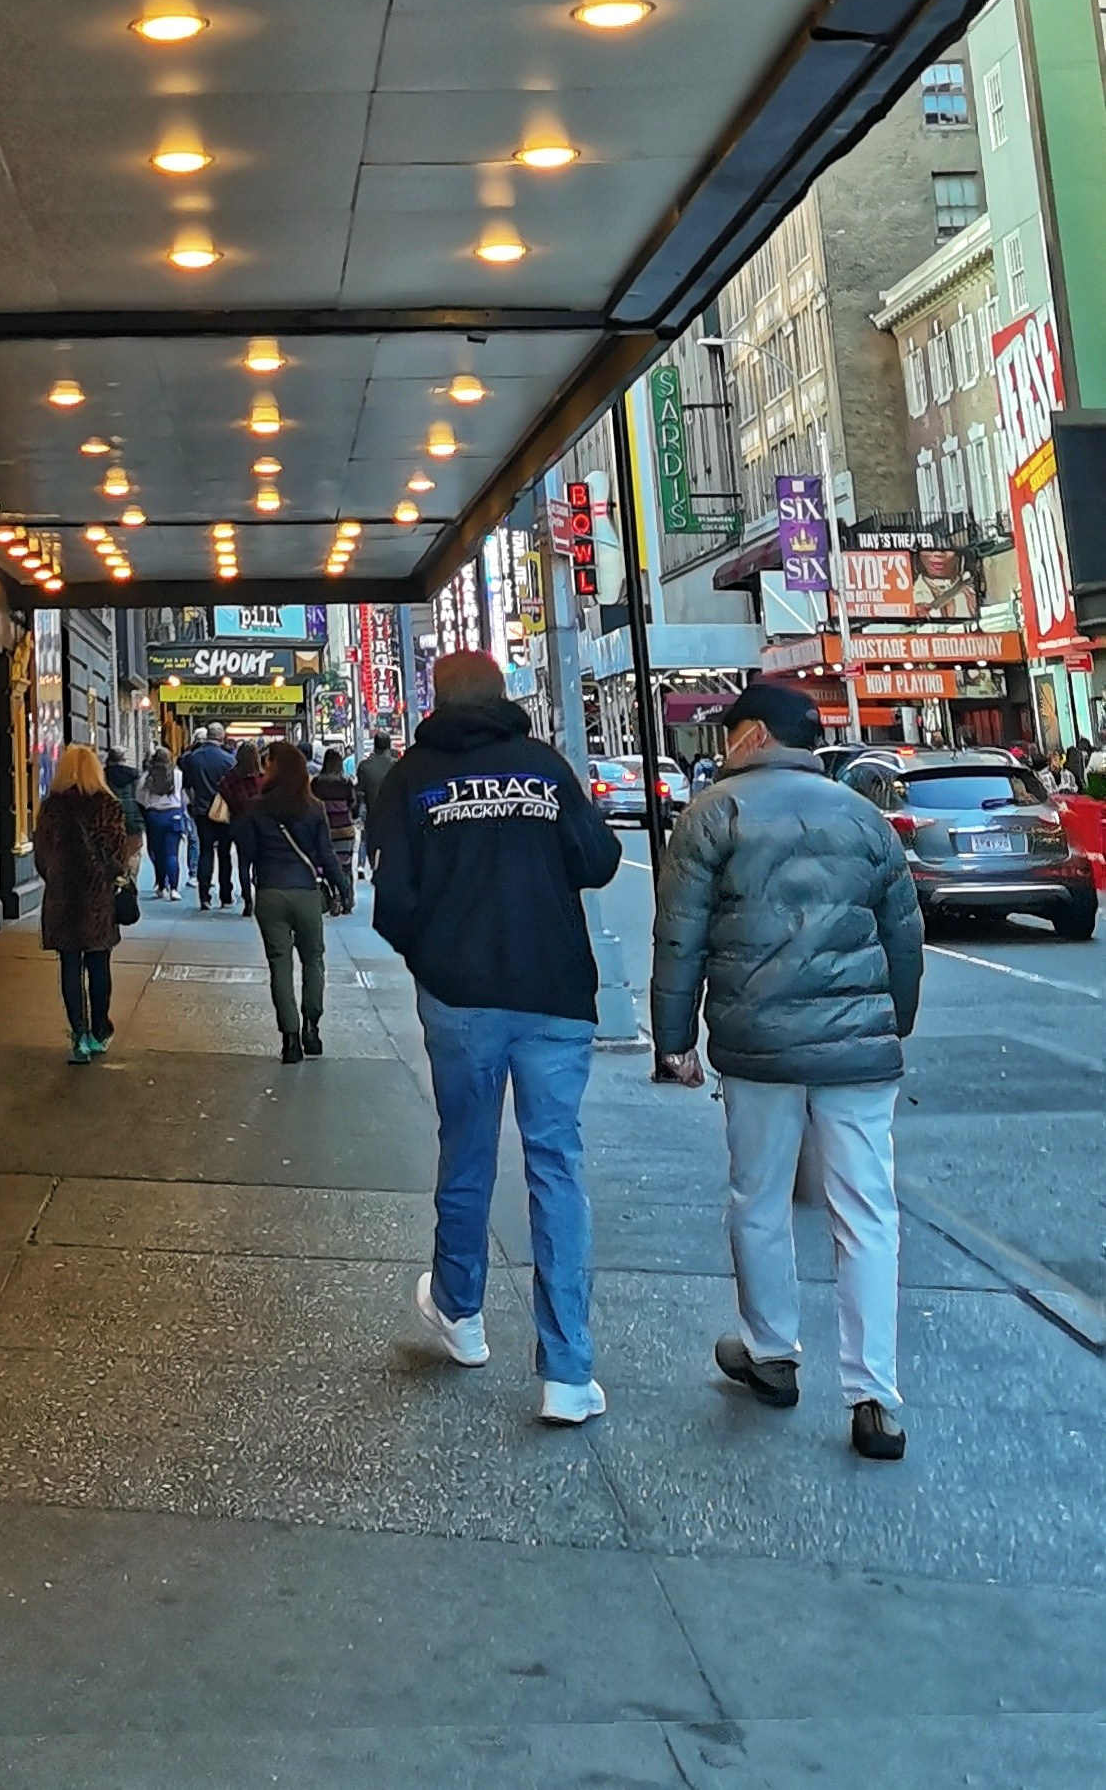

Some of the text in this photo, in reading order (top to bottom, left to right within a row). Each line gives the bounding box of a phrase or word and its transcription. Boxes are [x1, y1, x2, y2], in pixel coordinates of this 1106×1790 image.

[779, 496, 823, 522] SIX
[570, 485, 595, 594] BOWL
[785, 555, 829, 581] SIX
[866, 673, 944, 694] NOW PLAYING
[432, 803, 558, 826] JTRACKNY.COM
